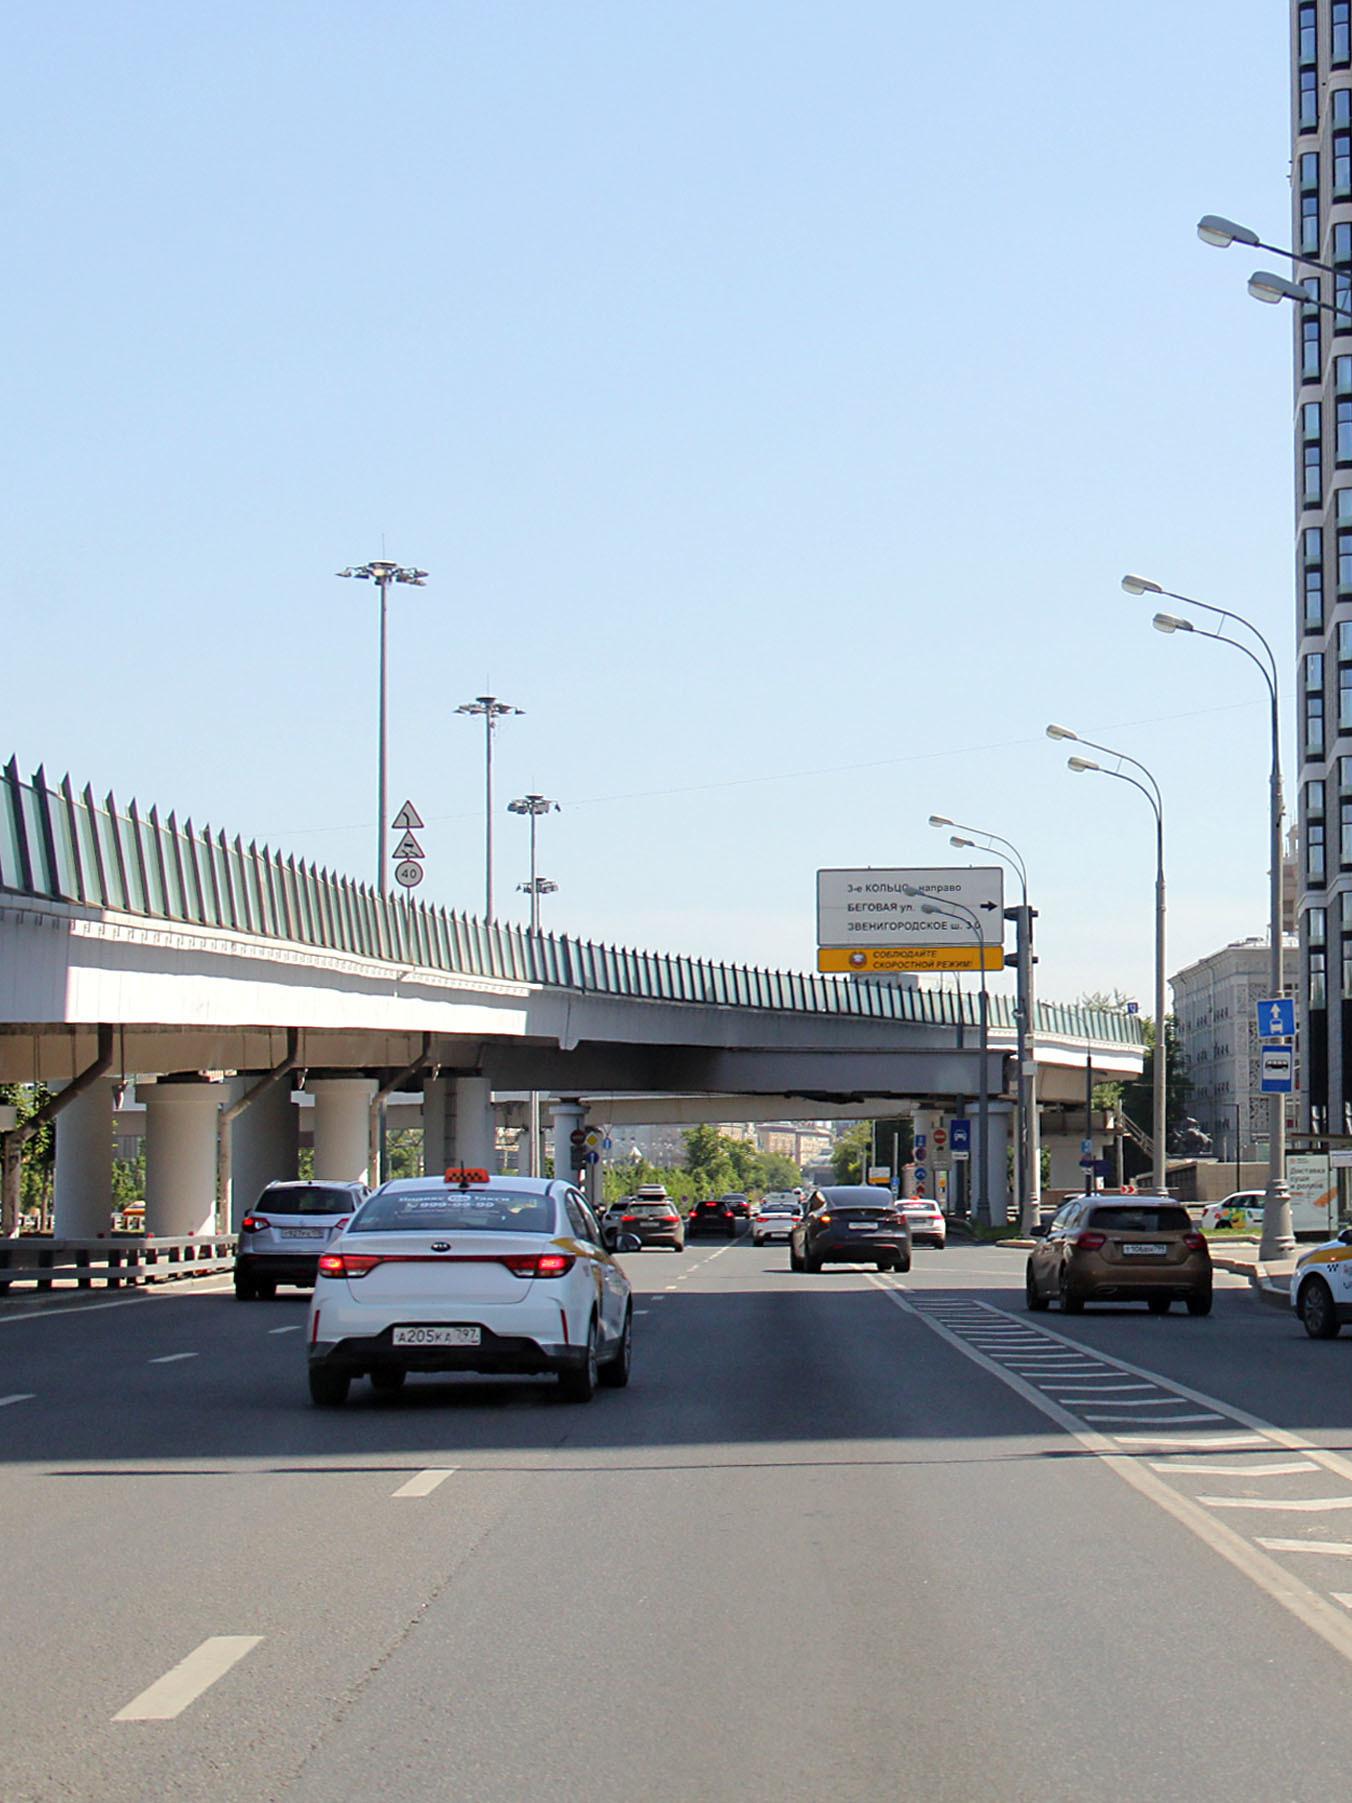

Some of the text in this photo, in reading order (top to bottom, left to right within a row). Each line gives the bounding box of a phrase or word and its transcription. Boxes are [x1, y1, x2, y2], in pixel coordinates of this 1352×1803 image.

[402, 869, 417, 879] 40
[919, 885, 961, 893] направо
[848, 903, 897, 912] БЕГОВАЯ
[848, 922, 947, 931] ЗВЕНИГОРОДСКОЕ
[873, 961, 934, 969] СКОРОСТНОЙ
